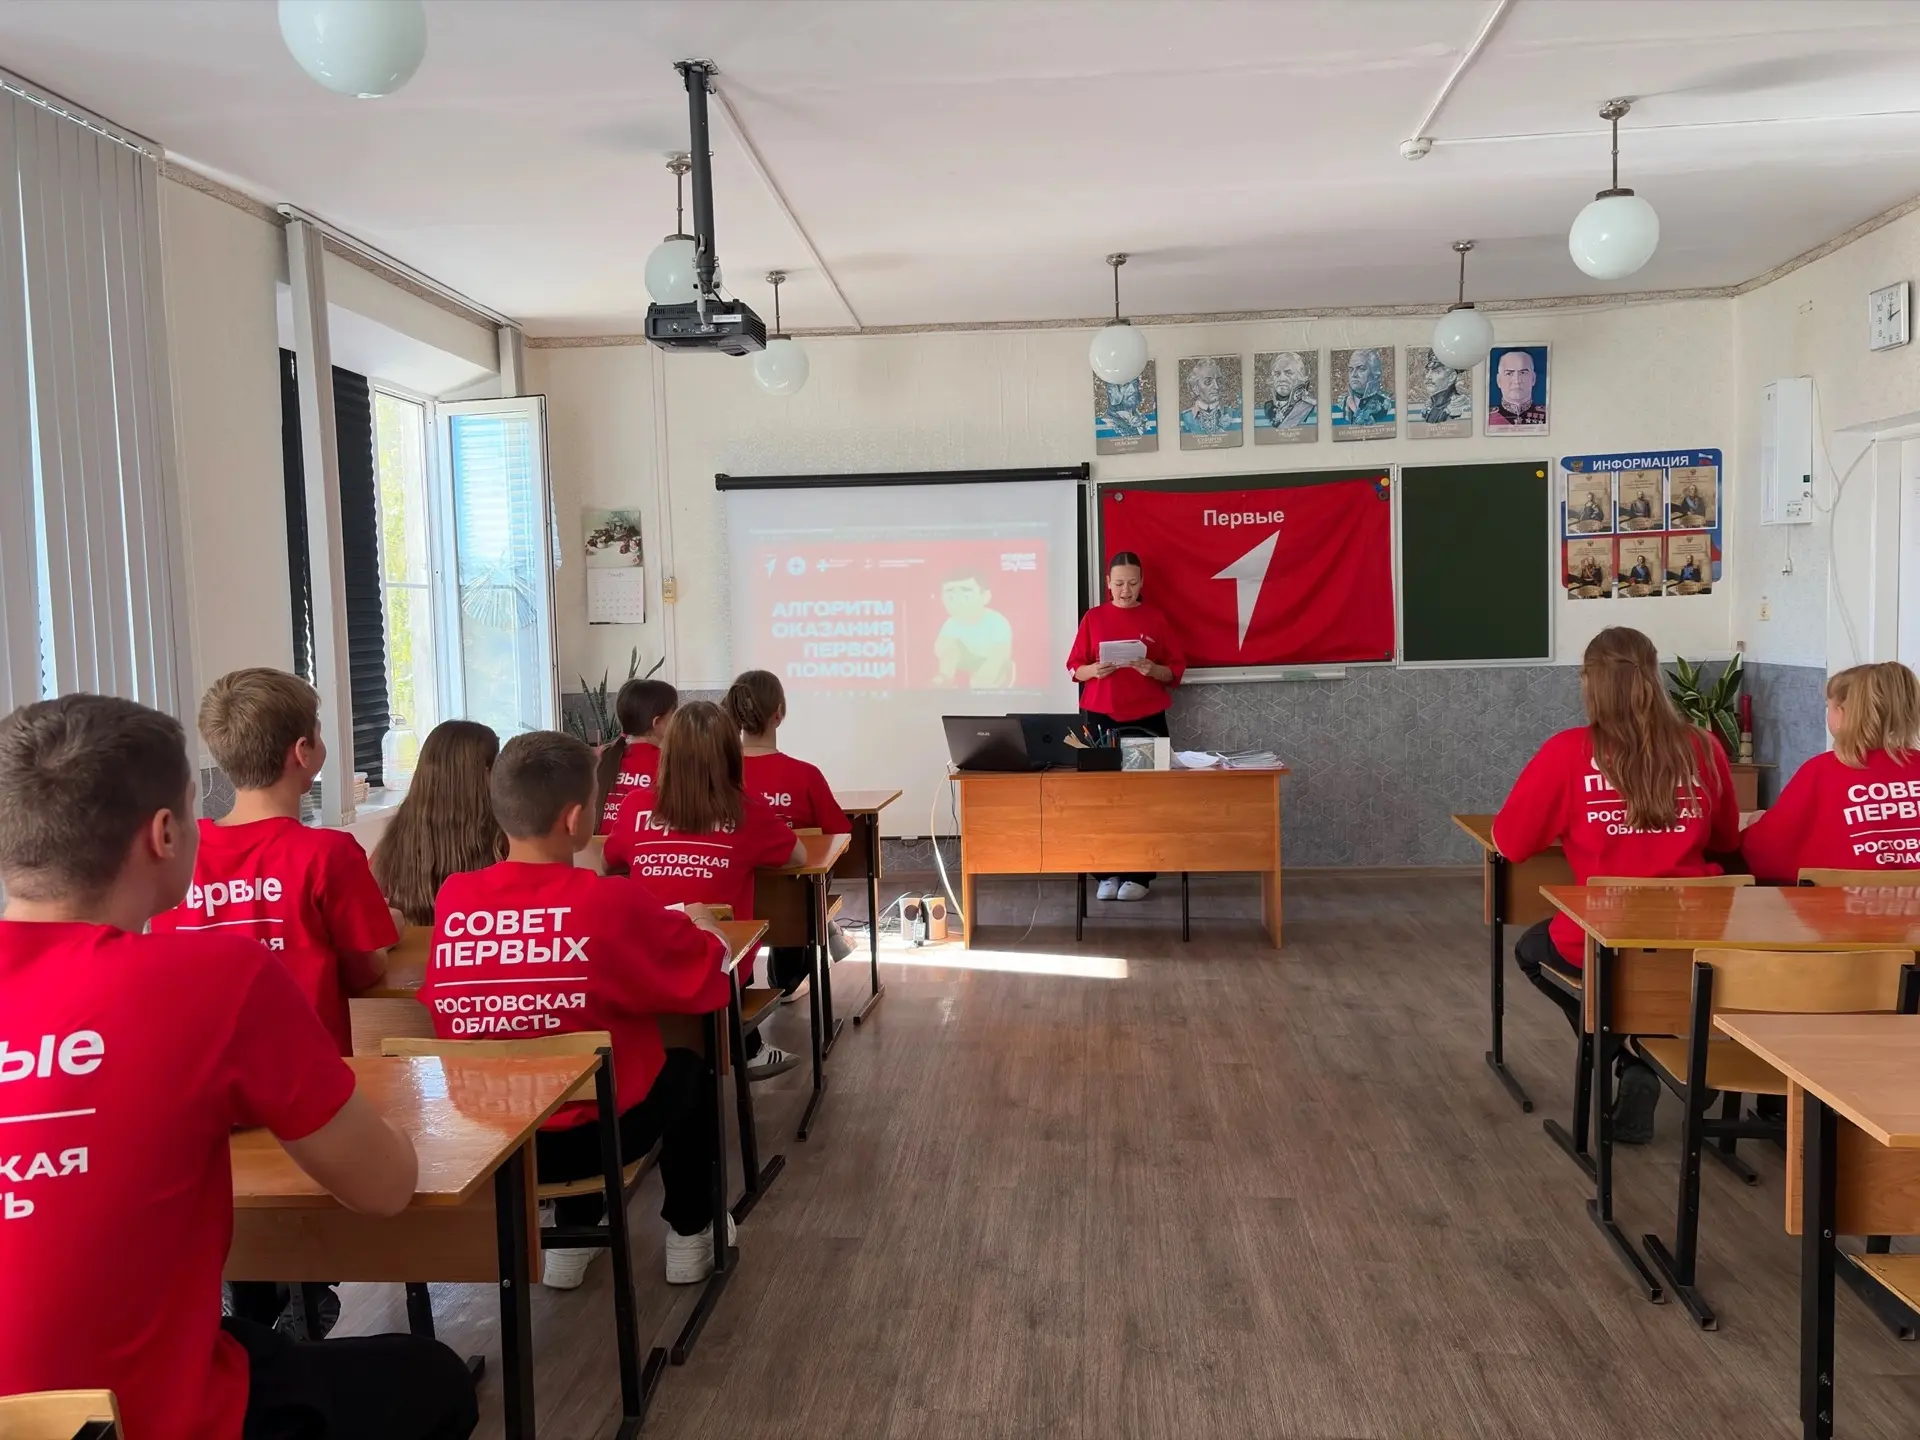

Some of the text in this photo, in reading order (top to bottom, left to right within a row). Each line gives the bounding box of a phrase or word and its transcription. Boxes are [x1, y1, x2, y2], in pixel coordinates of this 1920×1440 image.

[1593, 456, 1689, 471] ИНФОРМАЦИЯ
[1203, 510, 1285, 529] Первые
[772, 600, 894, 617] АЛГОРИТМ
[771, 620, 895, 638] ОКАЗАНИЯ
[803, 637, 895, 658] ПЕРВОЙ
[786, 661, 895, 679] ПОМОЩИ
[1847, 780, 1920, 803] СОВЕ
[1843, 800, 1920, 826] ПЕРВ
[1852, 838, 1920, 856] РОСТОВ
[633, 854, 729, 868] РОСТОВСКАЯ
[642, 866, 713, 879] ОБЛАСТЬ
[173, 877, 282, 917] ервые
[444, 907, 571, 938] СОВЕТ
[435, 936, 590, 969] ПЕРВЫХ
[434, 992, 586, 1014] РОСТОВСКАЯ
[452, 1014, 561, 1034] ОБЛАСТЬ
